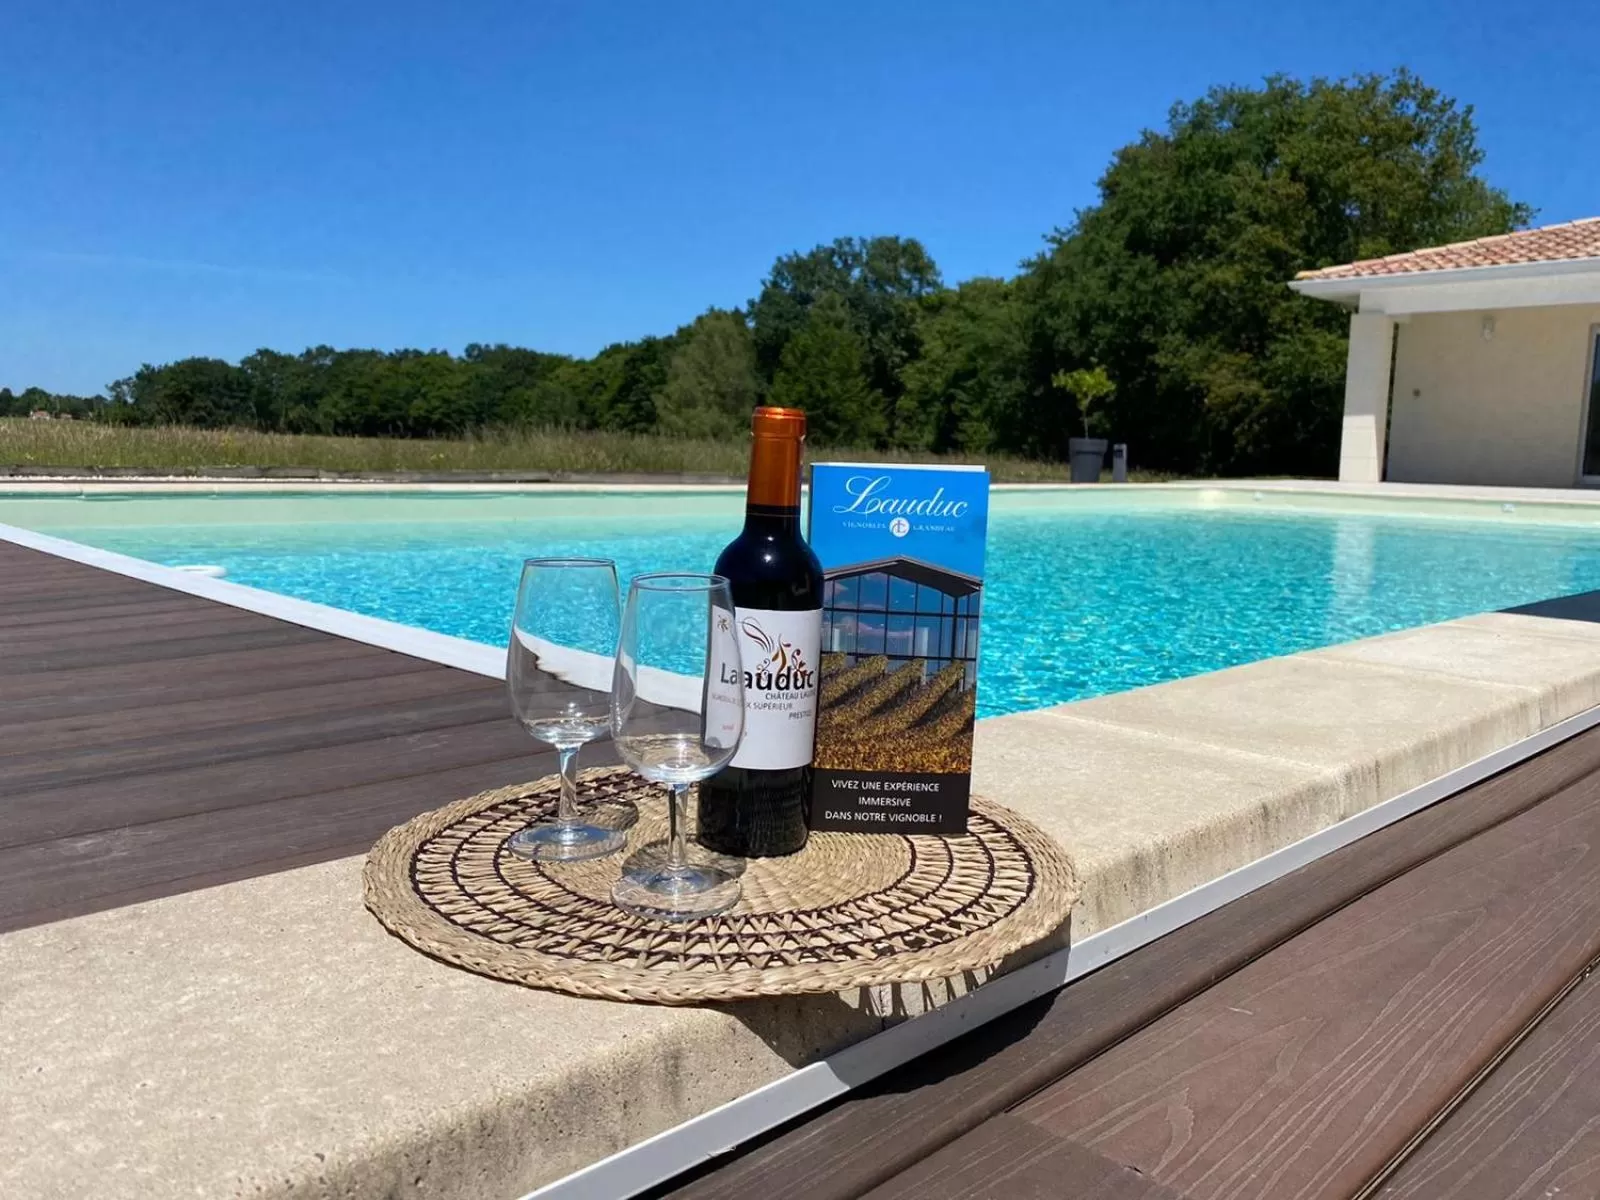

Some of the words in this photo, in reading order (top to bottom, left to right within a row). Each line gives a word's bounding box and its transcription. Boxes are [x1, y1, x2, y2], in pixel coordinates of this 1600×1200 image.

[832, 475, 968, 519] Lauduc
[765, 691, 798, 700] CHÂTEAU
[831, 779, 859, 790] VIVEZ
[861, 782, 881, 791] UNE
[884, 781, 940, 792] EXPÉRIENCE
[858, 797, 912, 807] IMMERSIVE
[825, 811, 852, 820] DANS
[854, 812, 886, 822] NOTRE
[888, 813, 936, 823] VIGNOBLE
